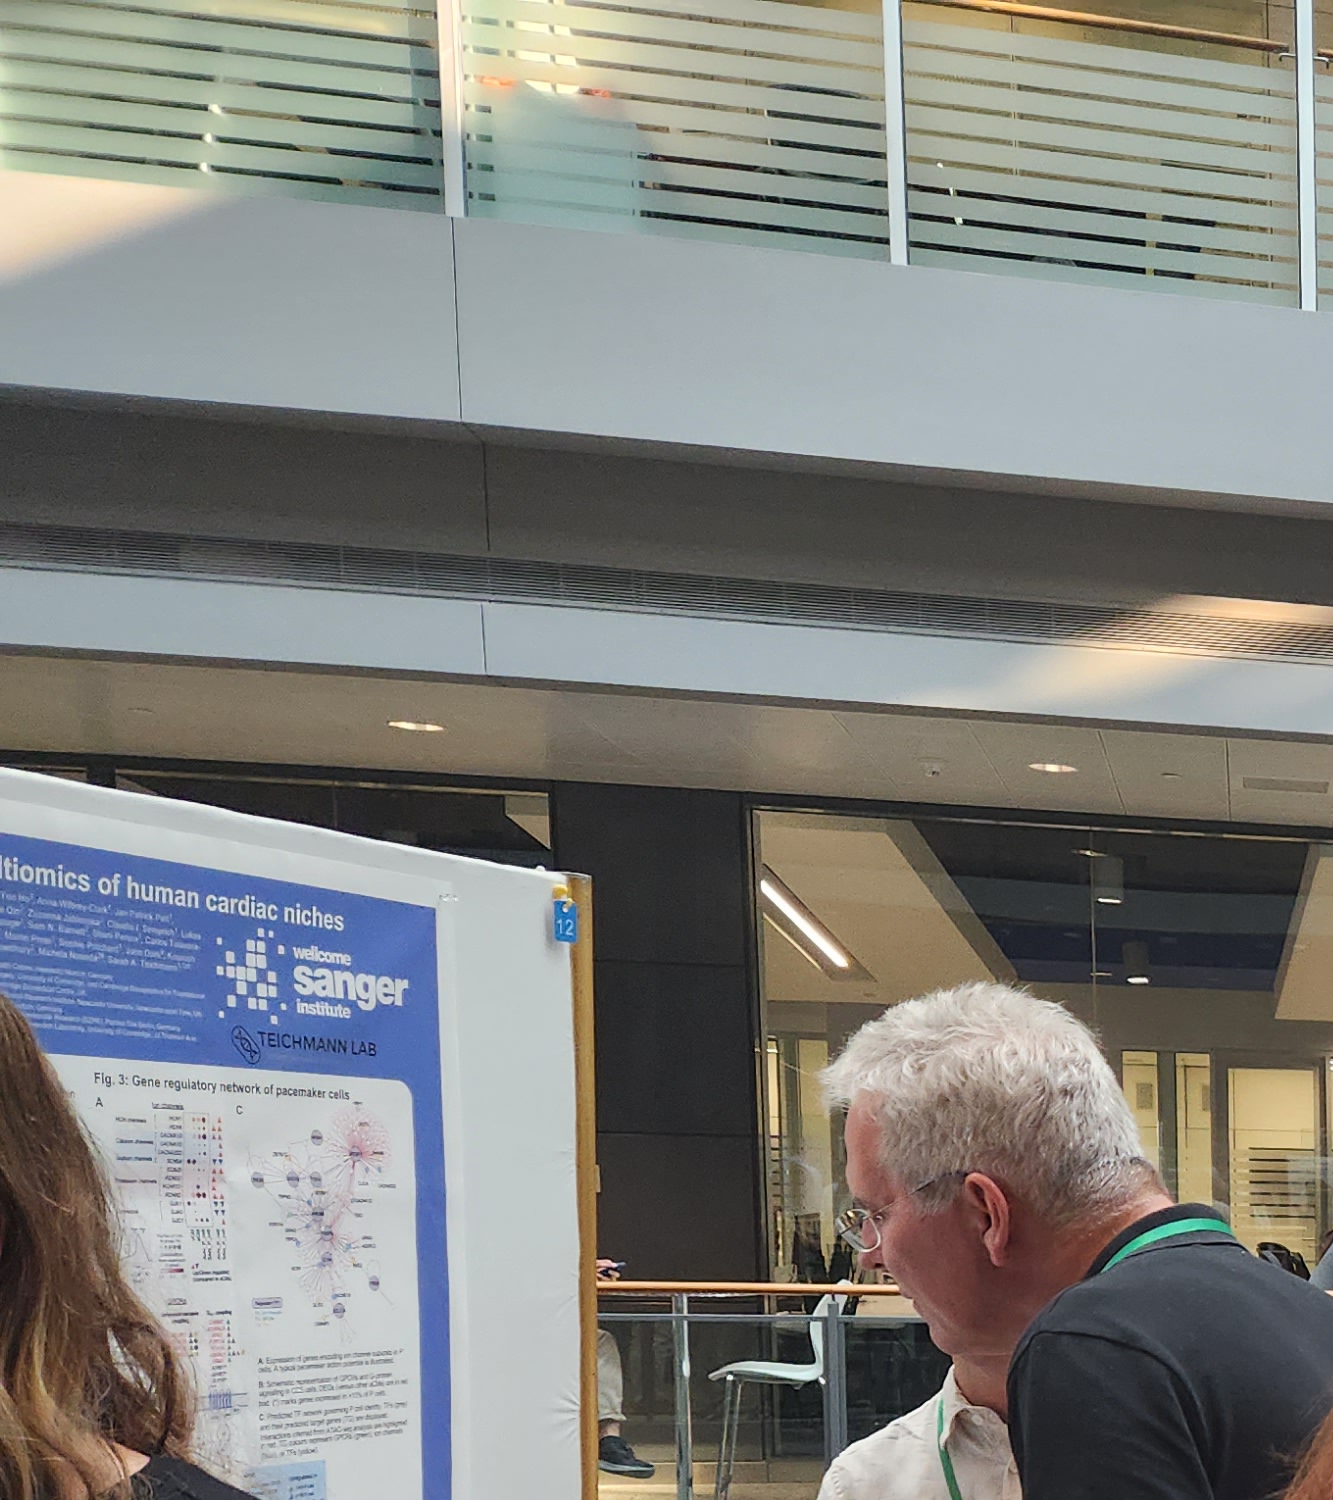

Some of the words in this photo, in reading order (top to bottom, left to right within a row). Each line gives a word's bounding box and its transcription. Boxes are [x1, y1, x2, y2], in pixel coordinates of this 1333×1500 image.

[98, 873, 120, 897] of
[126, 876, 199, 909] human
[205, 894, 279, 921] cardiac
[283, 903, 345, 931] niches
[556, 919, 574, 936] 12
[292, 945, 352, 966] wellcome
[293, 965, 409, 1011] sanger
[296, 998, 352, 1019] institute
[257, 1031, 348, 1054] TEICHMANN
[351, 1041, 377, 1057] LAB
[94, 1072, 116, 1088] Fig.
[118, 1074, 129, 1086] 3:
[132, 1075, 161, 1088] Gene
[164, 1078, 217, 1094] regulatory
[219, 1082, 262, 1095] network
[263, 1084, 275, 1095] of
[276, 1086, 327, 1099] pacemaker
[328, 1089, 350, 1100] cells
[95, 1097, 104, 1108] A
[236, 1105, 243, 1115] C
